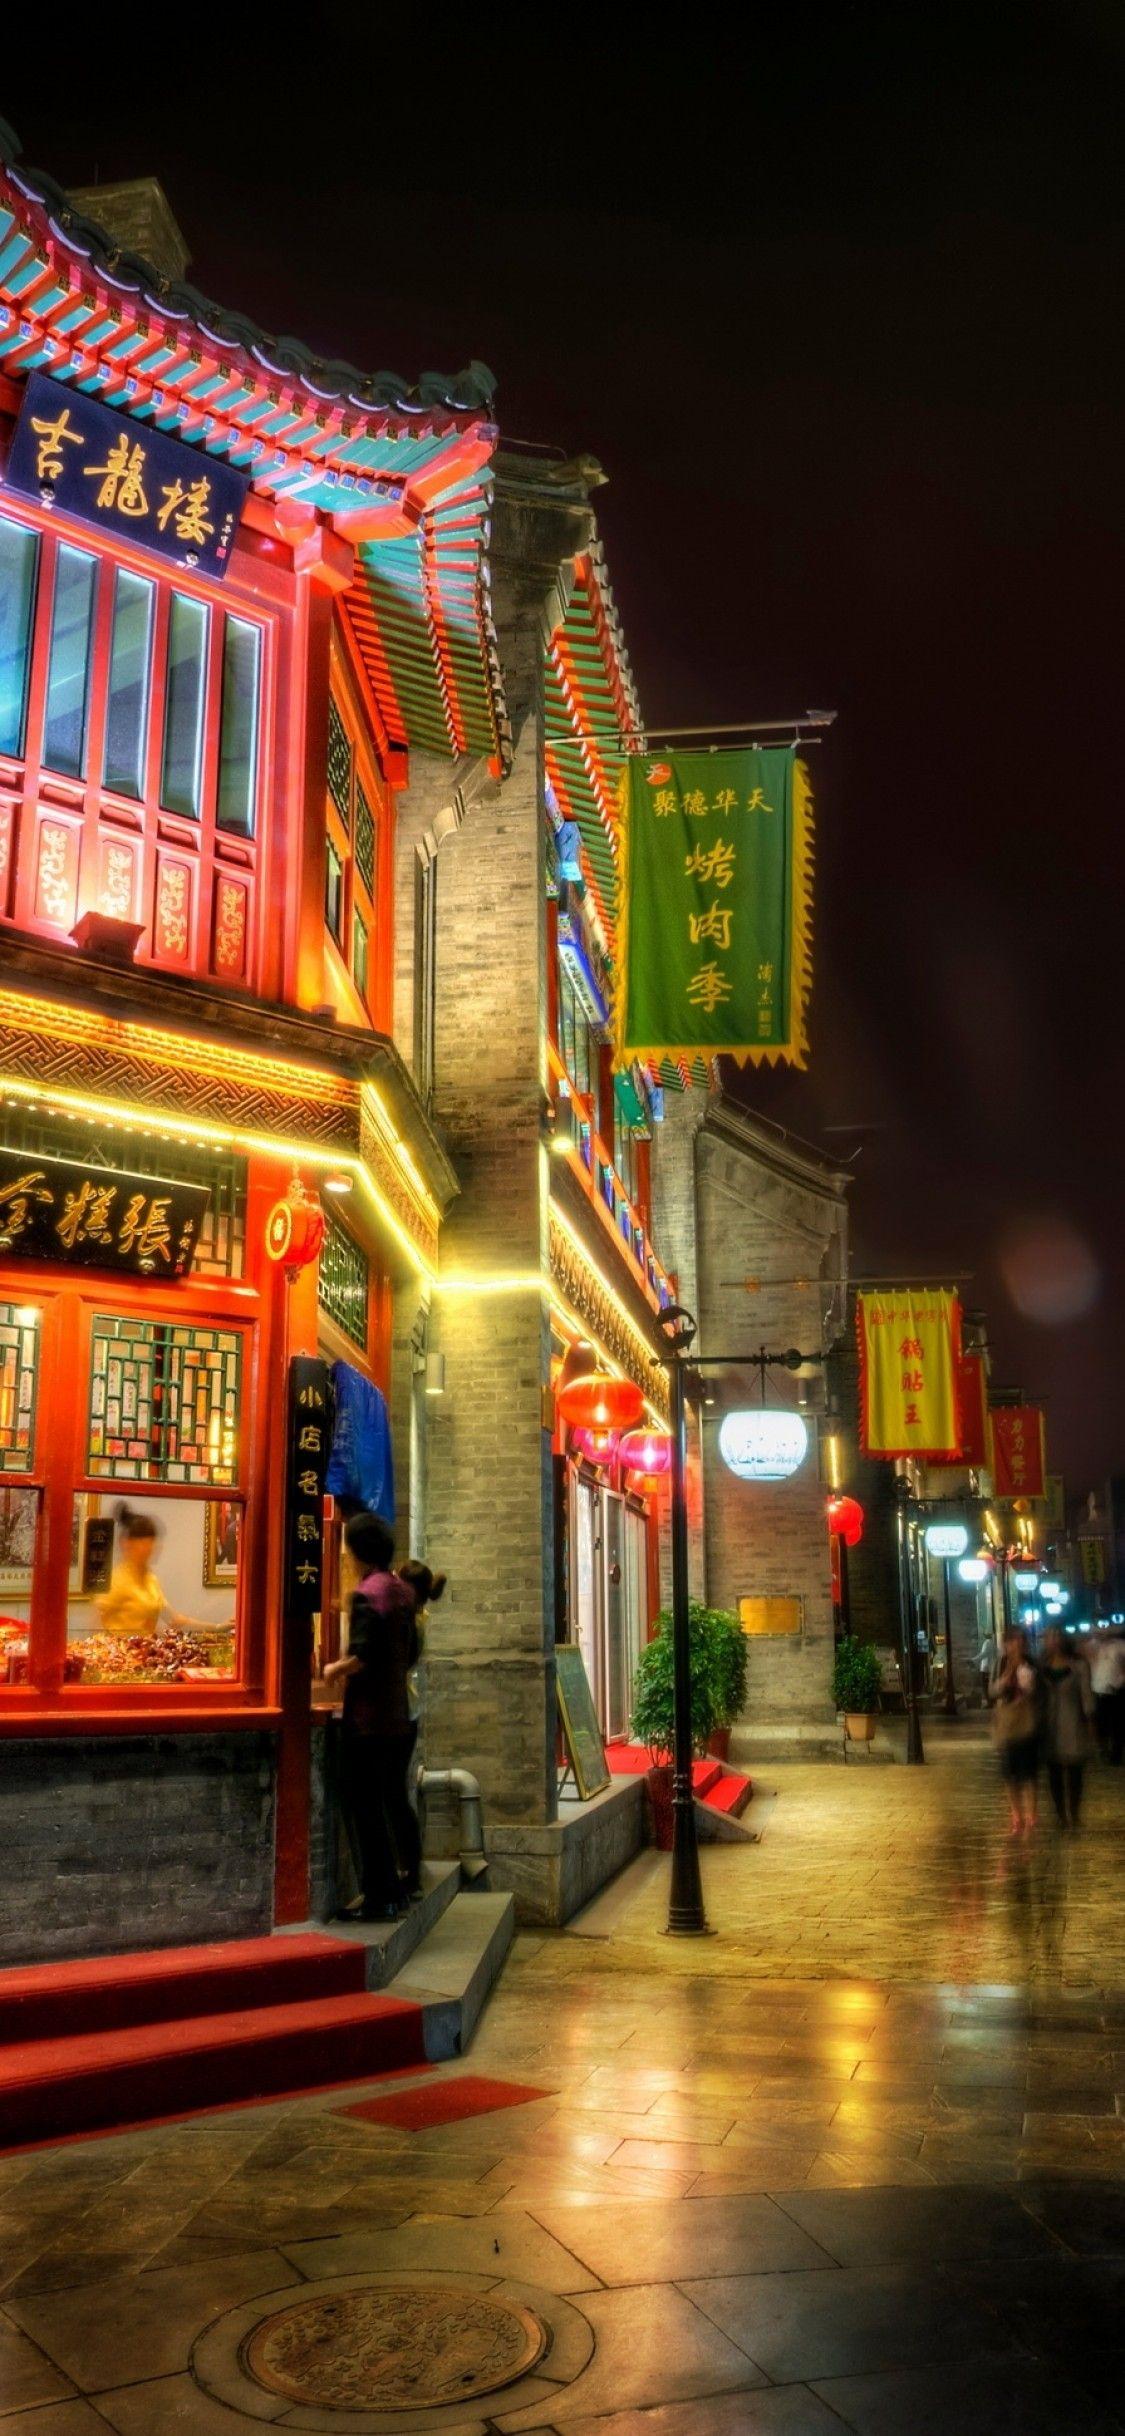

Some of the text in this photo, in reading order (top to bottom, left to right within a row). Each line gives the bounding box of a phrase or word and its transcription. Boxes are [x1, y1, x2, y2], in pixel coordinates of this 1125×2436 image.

[653, 787, 774, 817] 聚德华天
[684, 837, 737, 1014] 烤肉季
